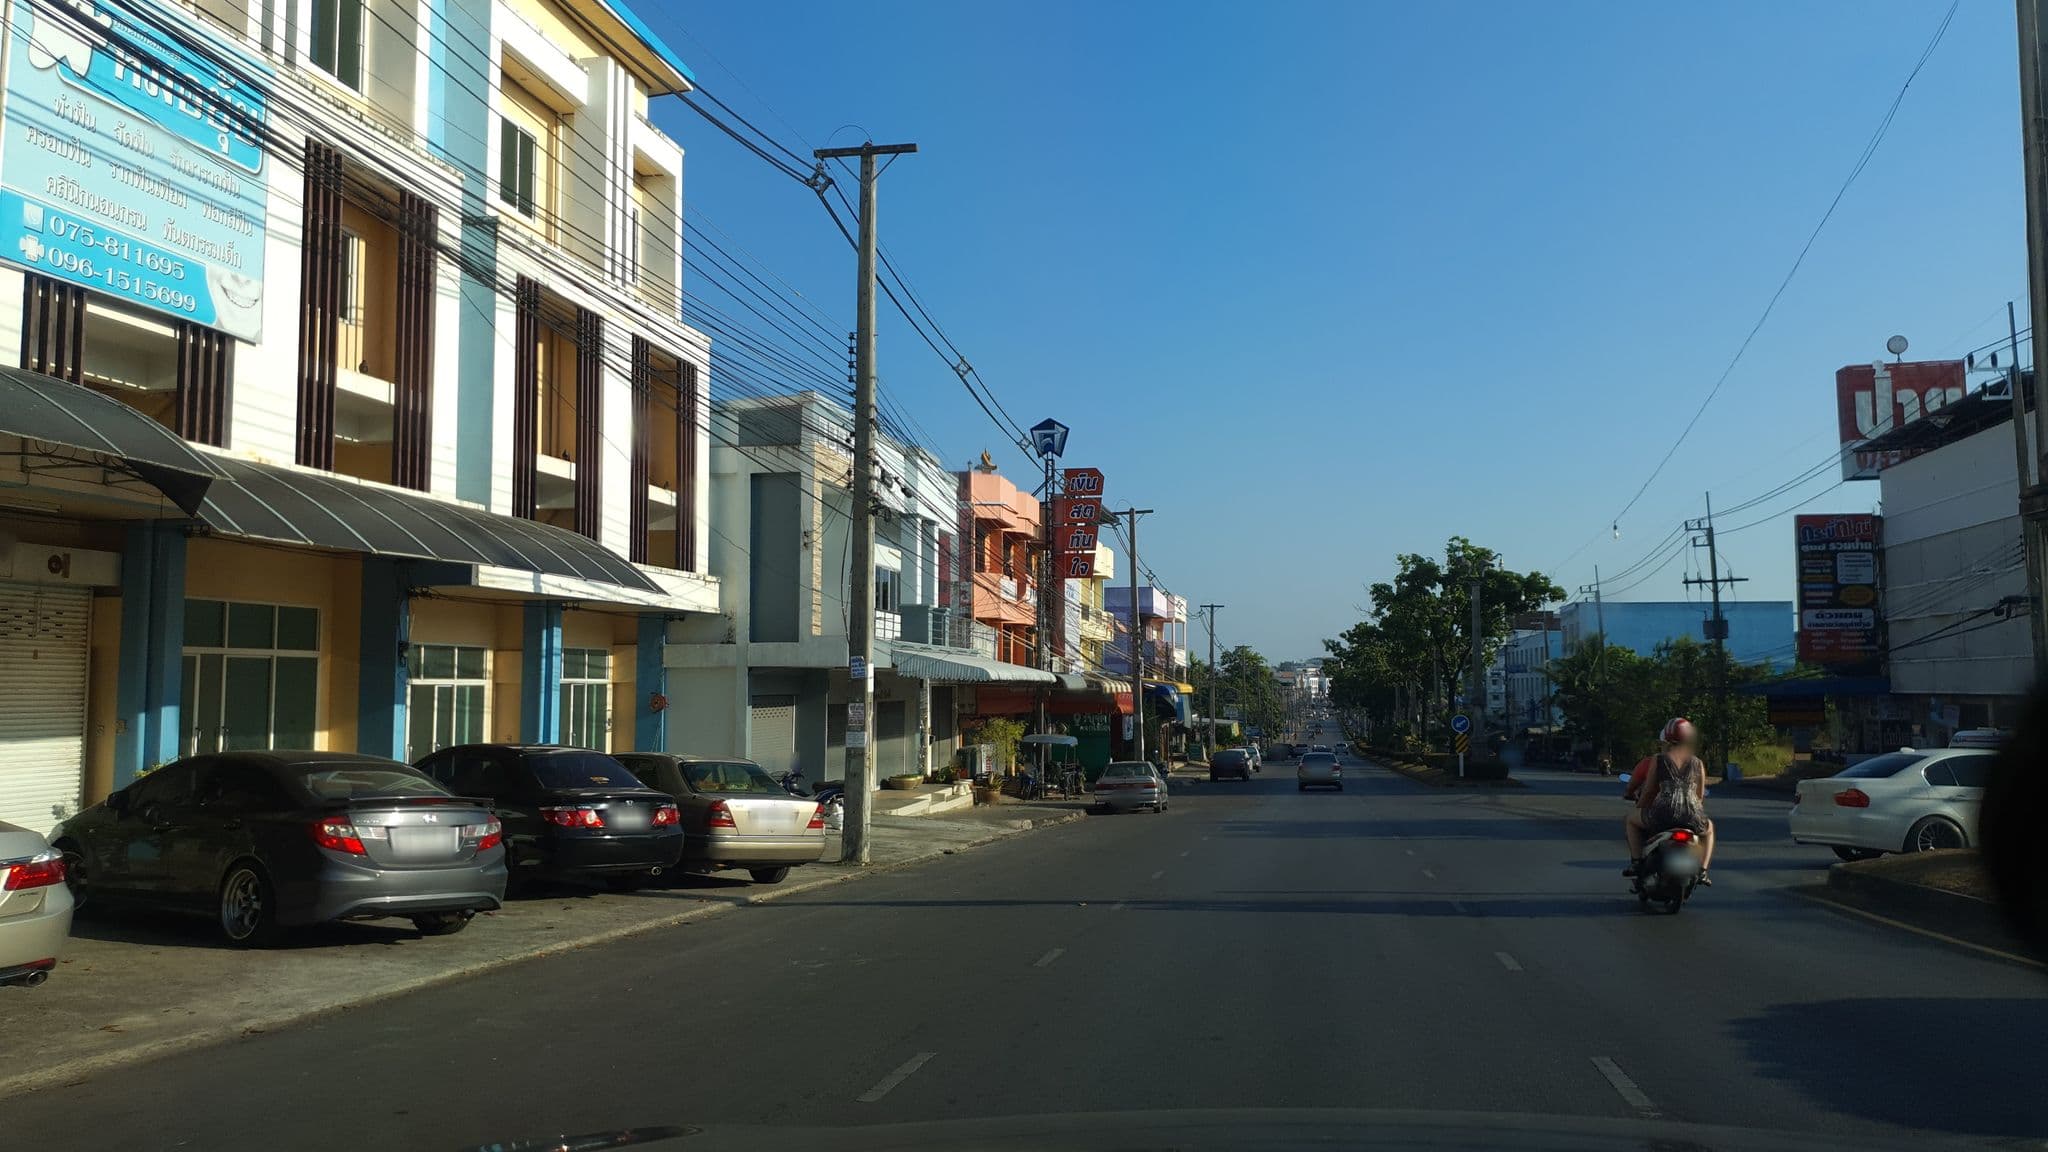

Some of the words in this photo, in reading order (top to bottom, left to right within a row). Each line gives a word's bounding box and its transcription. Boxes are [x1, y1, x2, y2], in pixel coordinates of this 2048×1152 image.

[54, 95, 97, 133] ทำฟัน
[114, 120, 155, 160] จัดฟัน
[169, 151, 241, 199] รักษารากฟัน
[25, 125, 93, 168] ครอบฟัน
[110, 160, 189, 209] รากฟันเทียม
[202, 199, 255, 237] ฟอกสีฟัน
[46, 174, 148, 231] คลินิกนอนกรน
[163, 217, 243, 269] ทันตกรรมเด็ก
[49, 214, 187, 281] 075-811695
[47, 247, 197, 313] 096-1515699
[1069, 473, 1099, 492] เงิน
[1070, 504, 1096, 519] สด
[1069, 530, 1094, 549] ทัน
[1070, 557, 1089, 576] ใจ
